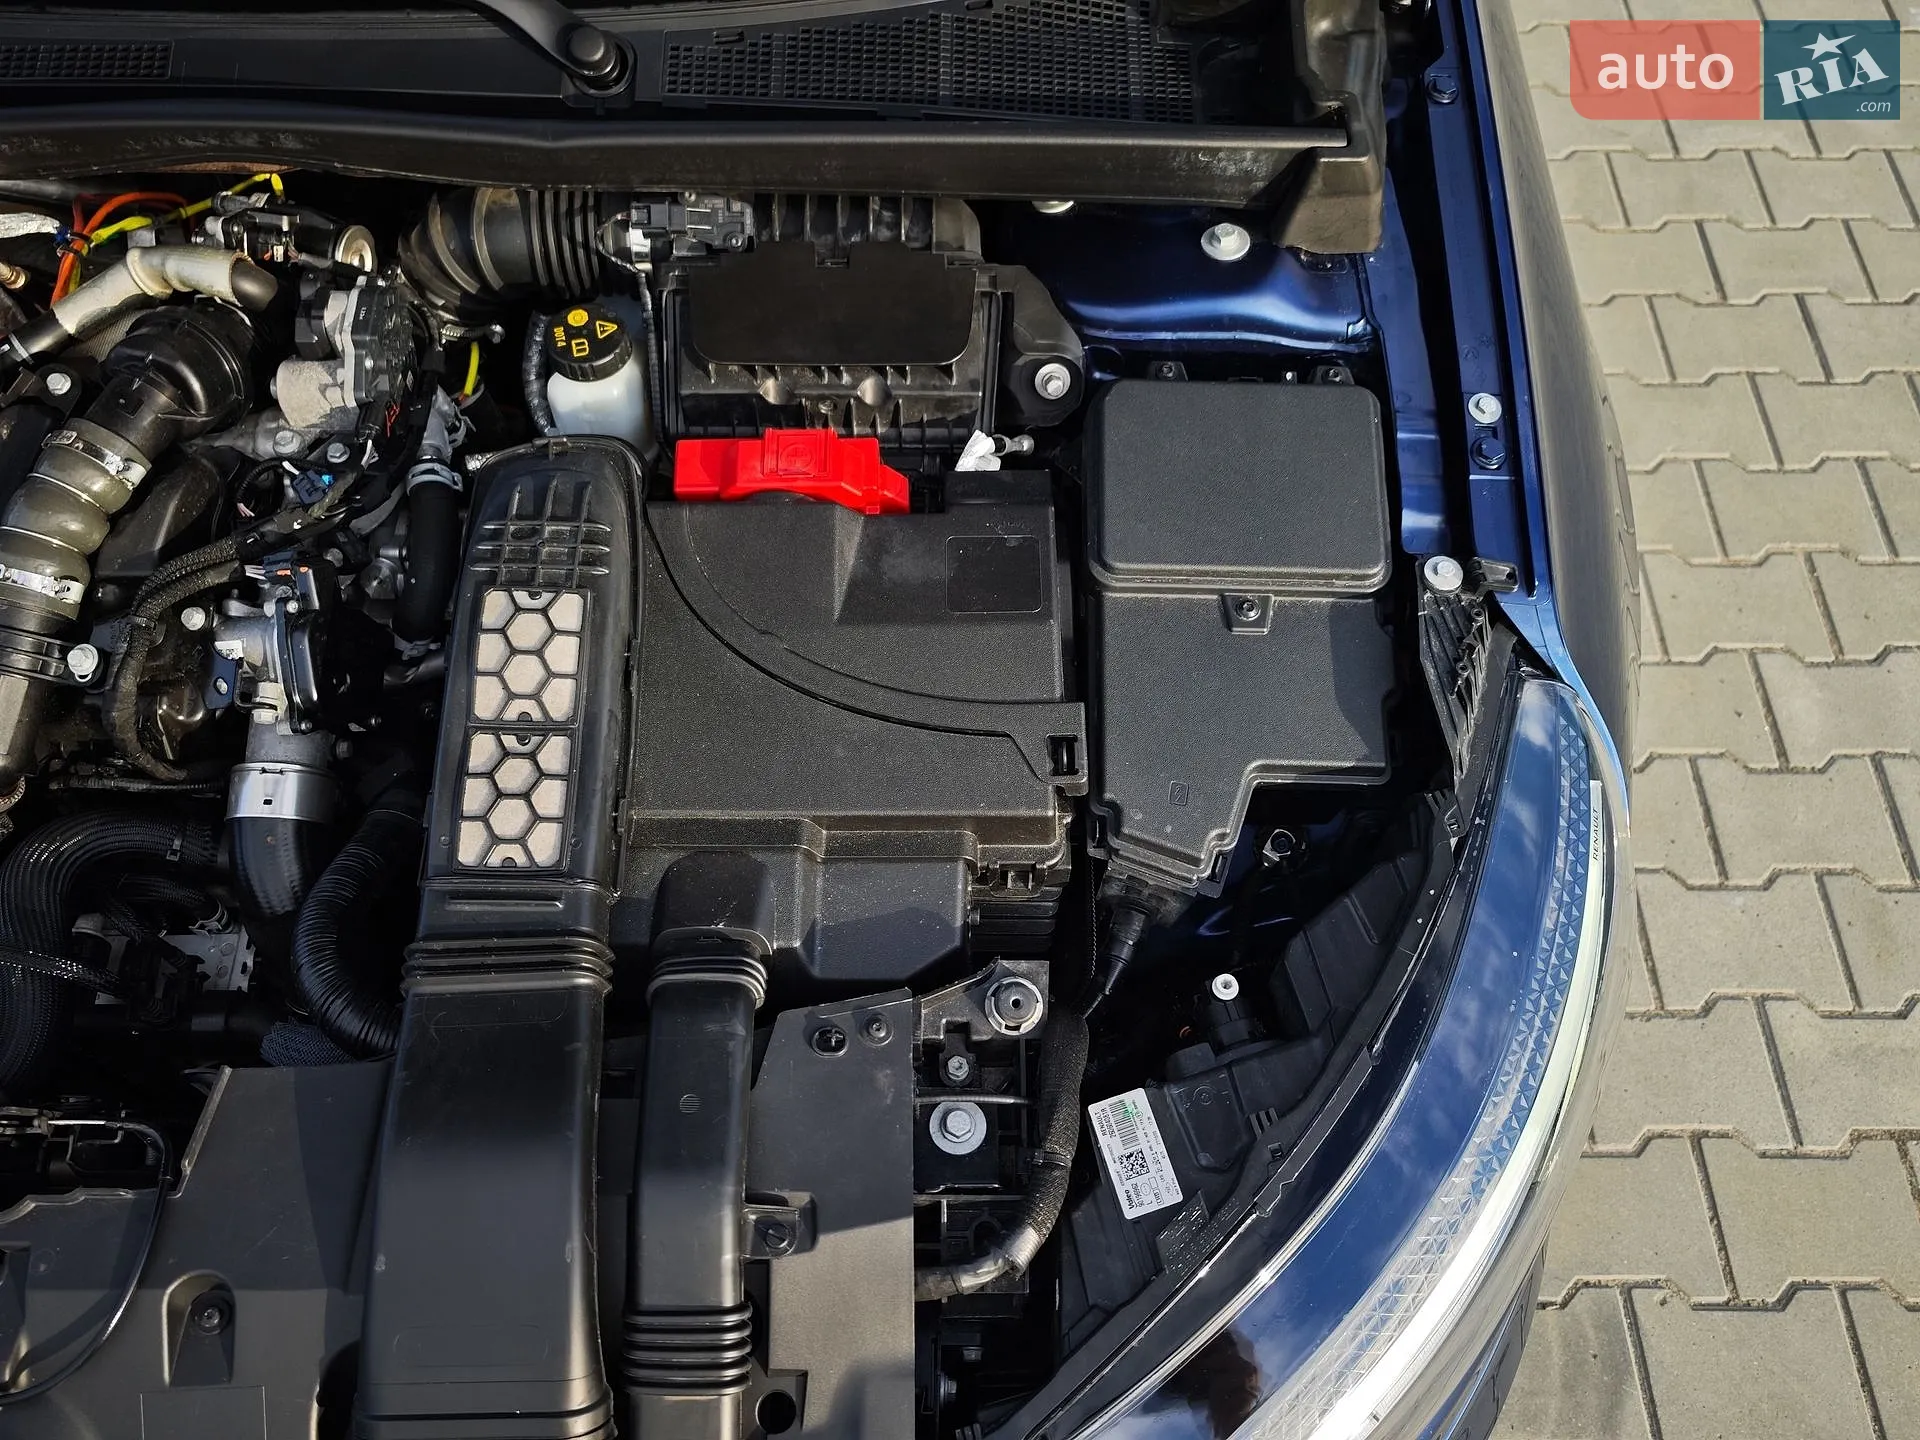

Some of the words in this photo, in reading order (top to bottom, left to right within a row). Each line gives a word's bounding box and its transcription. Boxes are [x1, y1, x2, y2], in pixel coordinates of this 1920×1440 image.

[554, 326, 566, 341] DOT
[1095, 1112, 1107, 1136] RENAULT
[1124, 1189, 1135, 1210] Valeo
